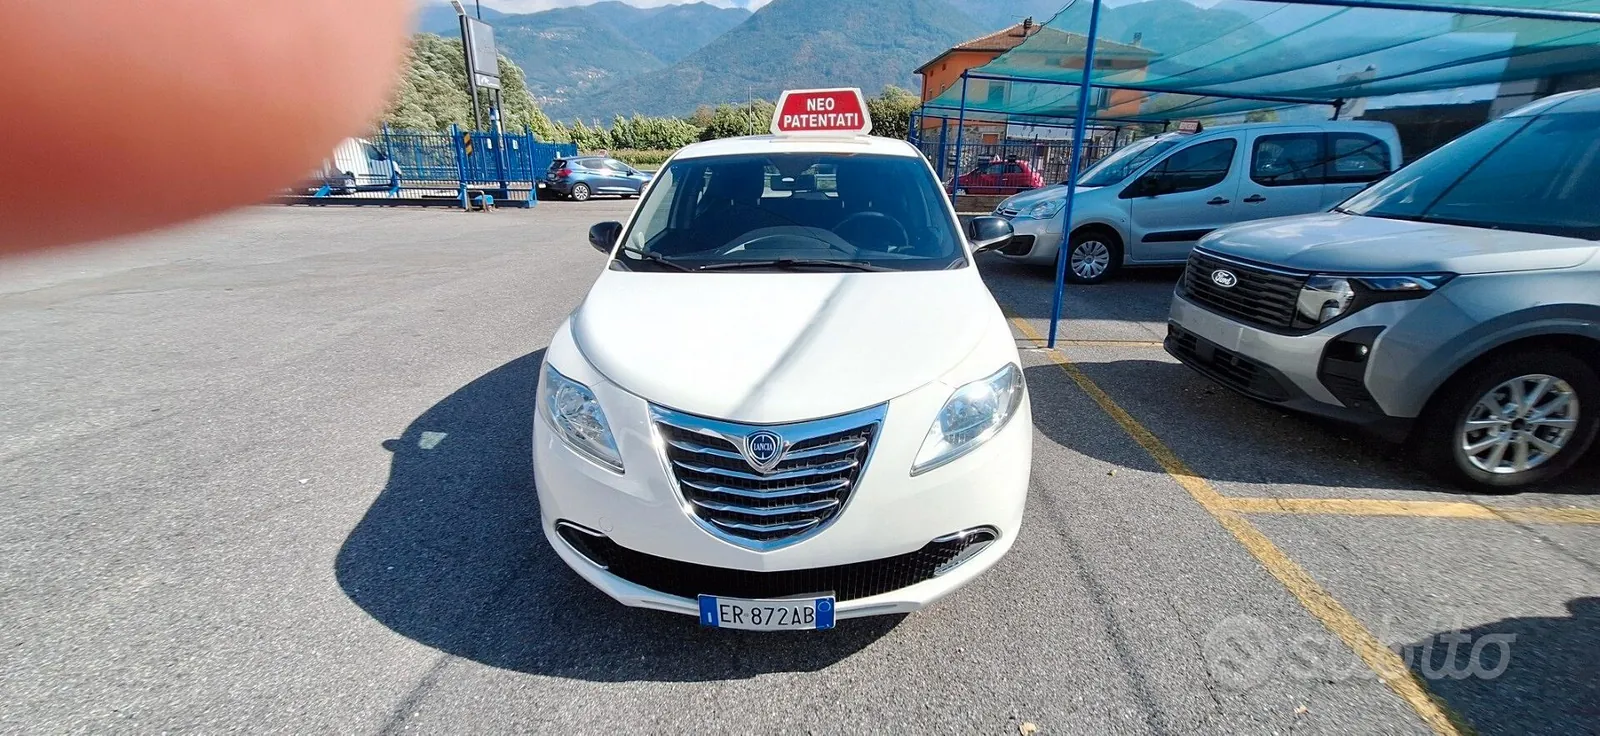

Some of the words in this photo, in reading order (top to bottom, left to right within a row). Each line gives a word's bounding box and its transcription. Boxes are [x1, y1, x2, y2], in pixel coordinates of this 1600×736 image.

[807, 97, 835, 111] NEO
[783, 113, 859, 128] PATENTATI
[1215, 271, 1232, 285] Ford
[754, 443, 773, 451] LANCIA
[719, 604, 743, 624] ER
[751, 607, 815, 625] 872AB
